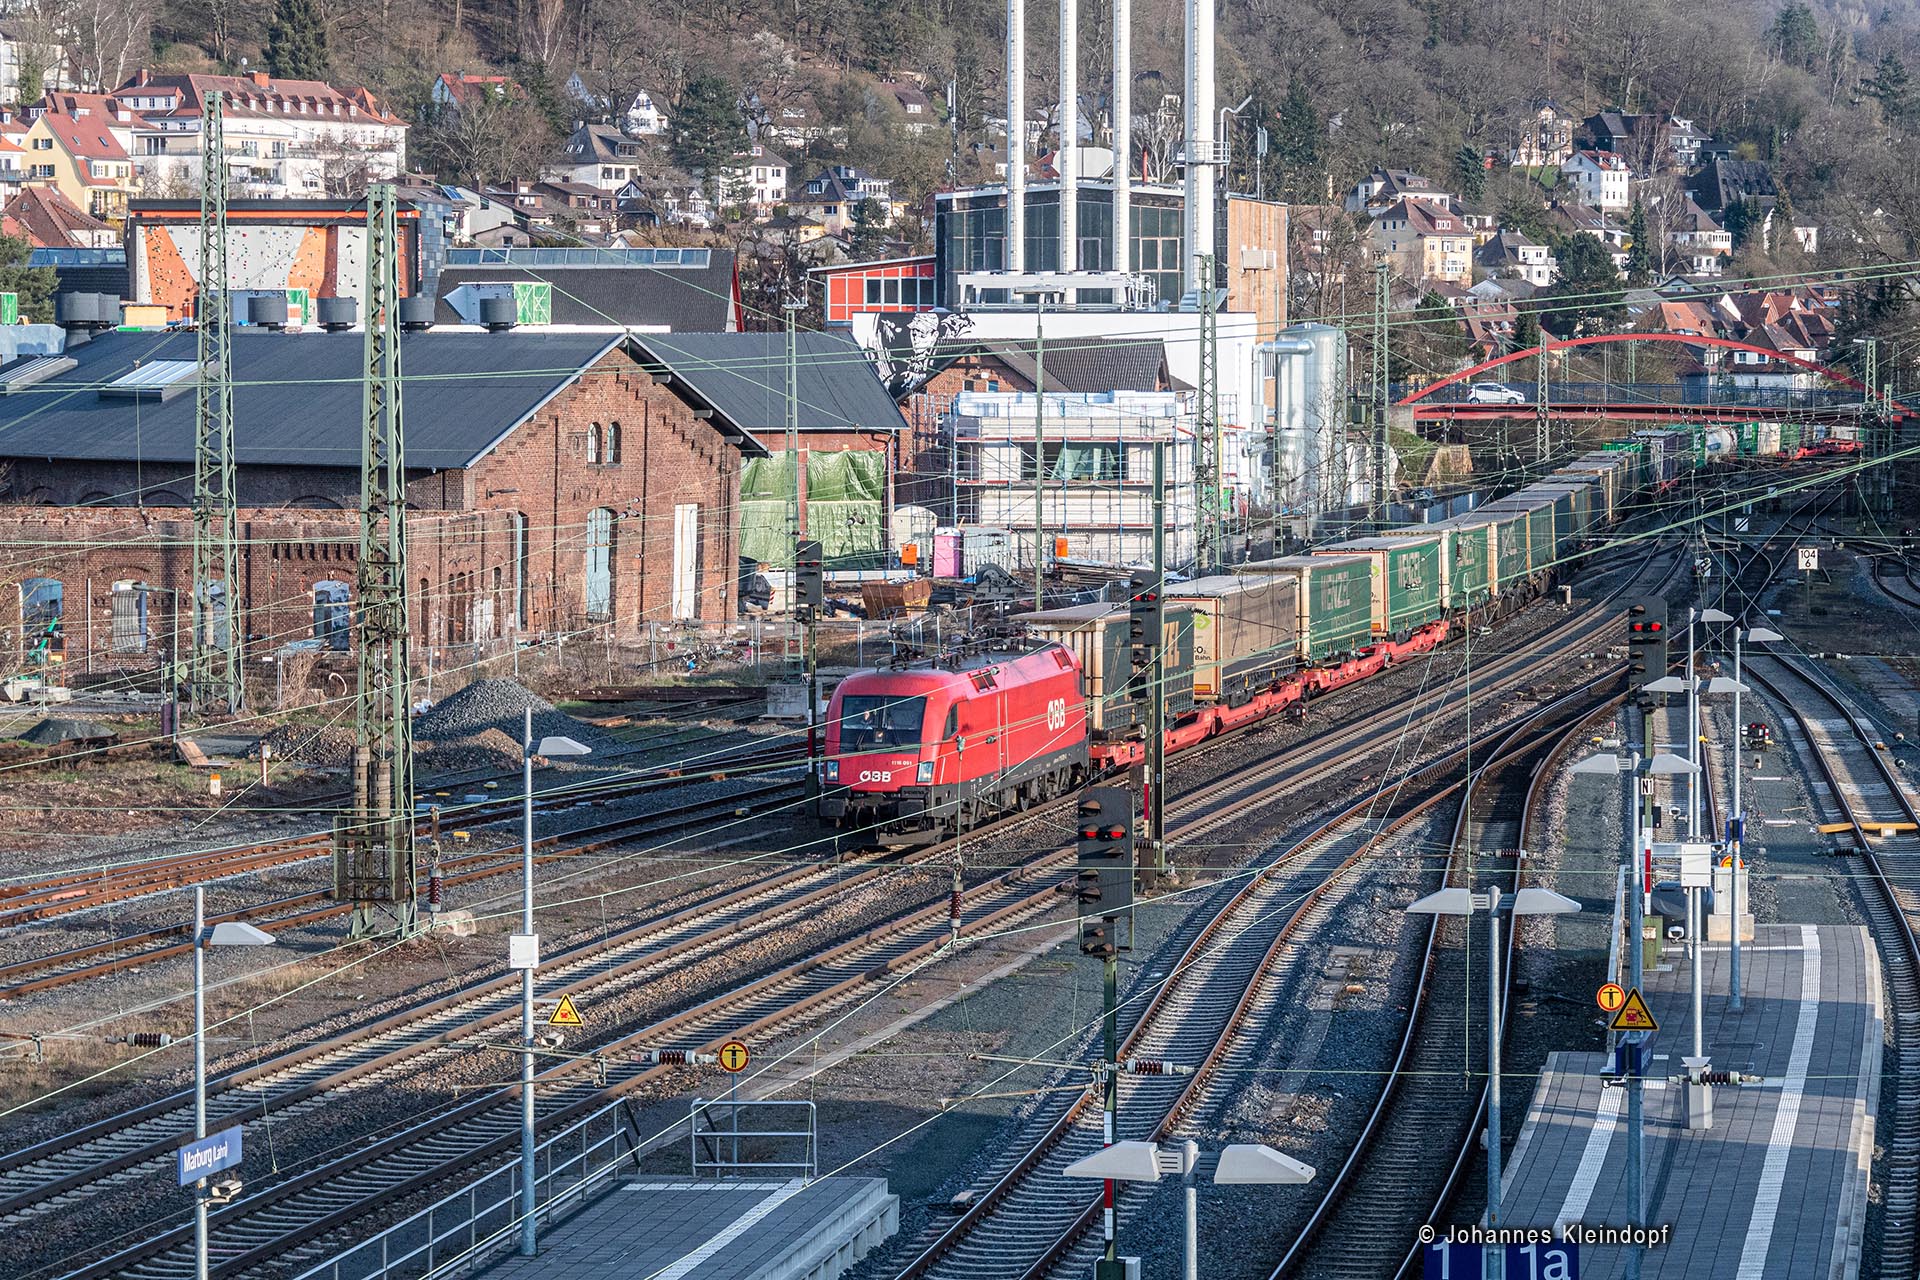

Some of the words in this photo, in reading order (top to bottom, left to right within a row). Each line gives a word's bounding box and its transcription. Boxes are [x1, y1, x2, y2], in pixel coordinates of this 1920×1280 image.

[1800, 550, 1816, 558] 104
[1805, 559, 1811, 567] 6
[860, 770, 892, 782] ÖBB
[184, 1148, 212, 1173] Marburg
[213, 1140, 228, 1162] (Lahn)
[1519, 1242, 1571, 1280] 1a
